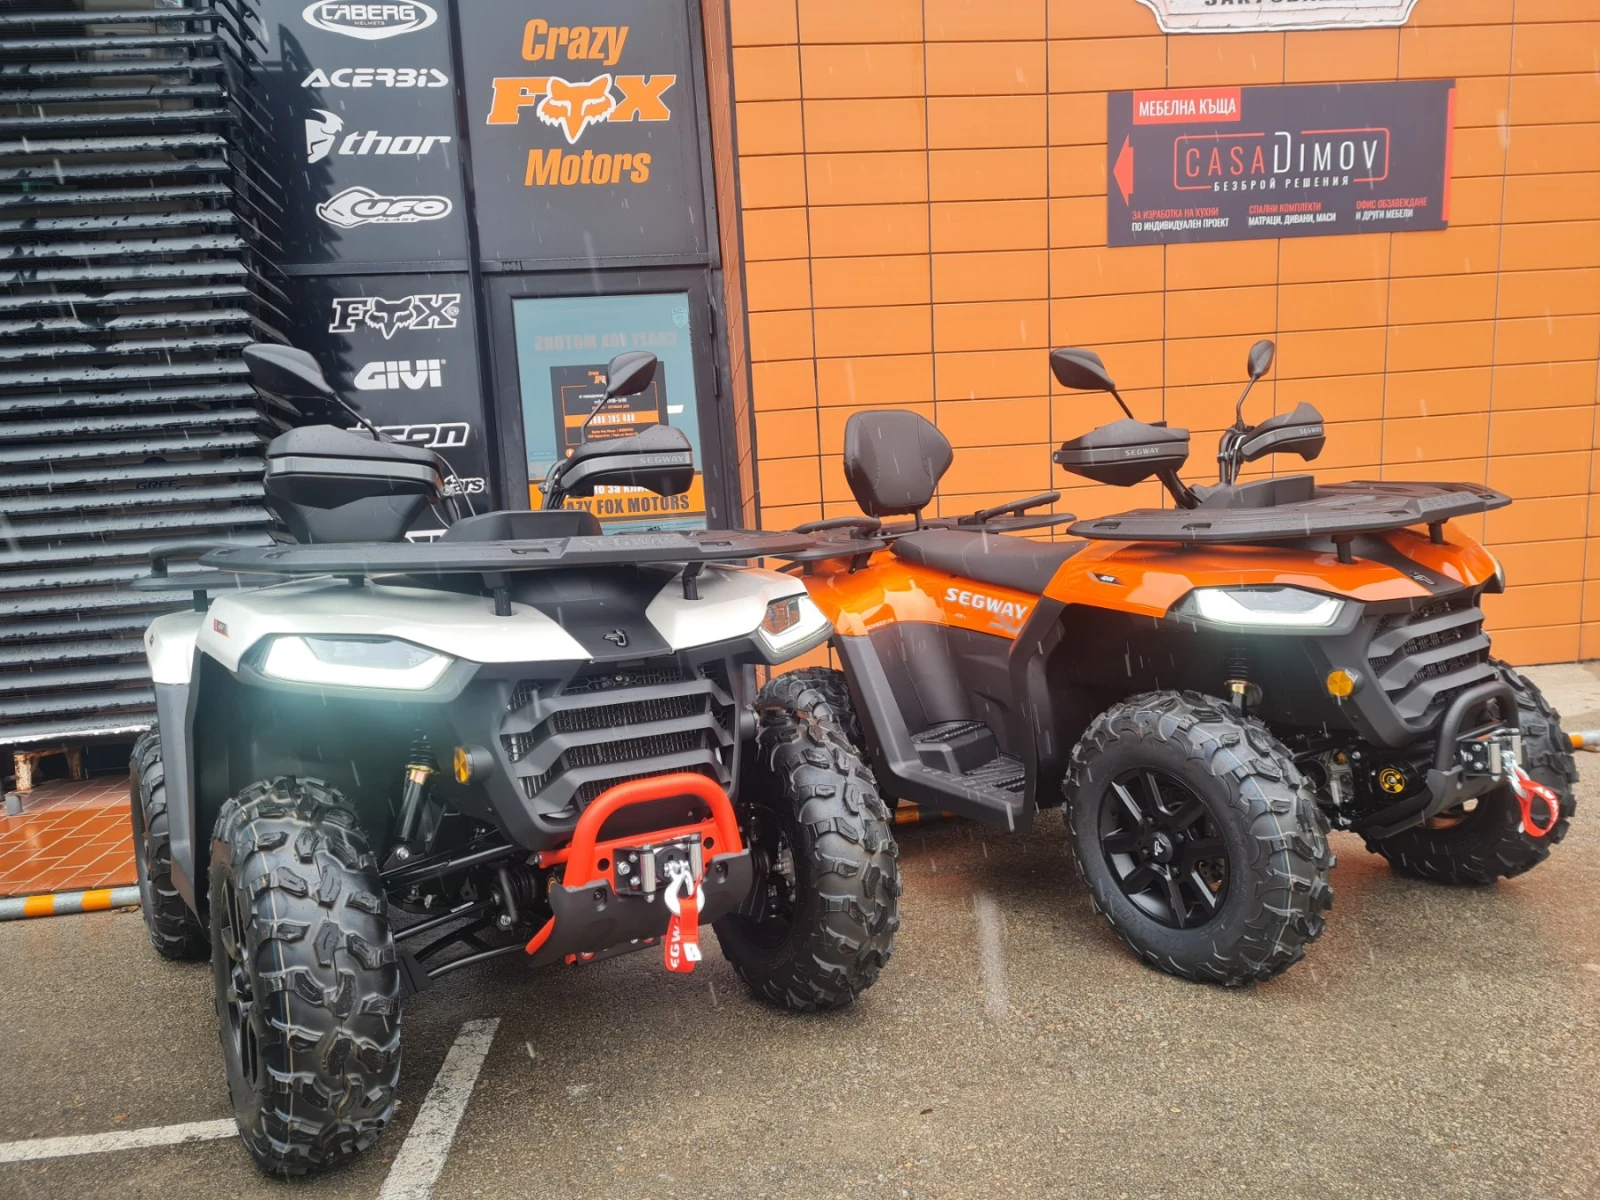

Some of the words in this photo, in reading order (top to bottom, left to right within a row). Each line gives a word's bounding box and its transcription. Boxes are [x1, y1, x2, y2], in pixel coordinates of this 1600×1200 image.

[321, 5, 416, 20] CABERG
[521, 18, 629, 66] Crazy
[1139, 100, 1196, 117] МЕБЕЛНА
[1199, 98, 1236, 116] КЪЩА
[338, 130, 451, 155] thor
[524, 149, 651, 186] Motors
[1214, 178, 1276, 192] БЕЗБРОЙ
[1285, 176, 1350, 189] РЕШЕНИЯ
[354, 200, 445, 216] UFO
[1249, 204, 1278, 215] СПАЛНИ
[1280, 202, 1321, 213] КОМПЛЕКТИ
[1356, 200, 1375, 210] ОФИС
[1378, 197, 1427, 208] ОБЗАВЕЖДАНЕ
[1143, 209, 1182, 219] ИЗРАБОТКА
[1185, 208, 1194, 217] НА
[1195, 207, 1219, 217] КУХНИ
[1316, 212, 1336, 222] МАСИ
[1362, 209, 1384, 221] ДРУГИ
[1386, 208, 1413, 219] МЕБЕЛИ
[1132, 222, 1142, 232] ПО
[1144, 219, 1201, 231] ИНДИВИДУАЛЕН
[1203, 218, 1229, 228] ПРОЕКТ
[353, 359, 442, 390] GIVI
[1300, 427, 1322, 435] SEGWAY
[1125, 447, 1160, 456] SEGWAY
[639, 455, 684, 464] SEGWAY
[597, 499, 624, 515] FOX
[628, 495, 689, 513] MOTORS
[944, 587, 1028, 619] SEGWAY
